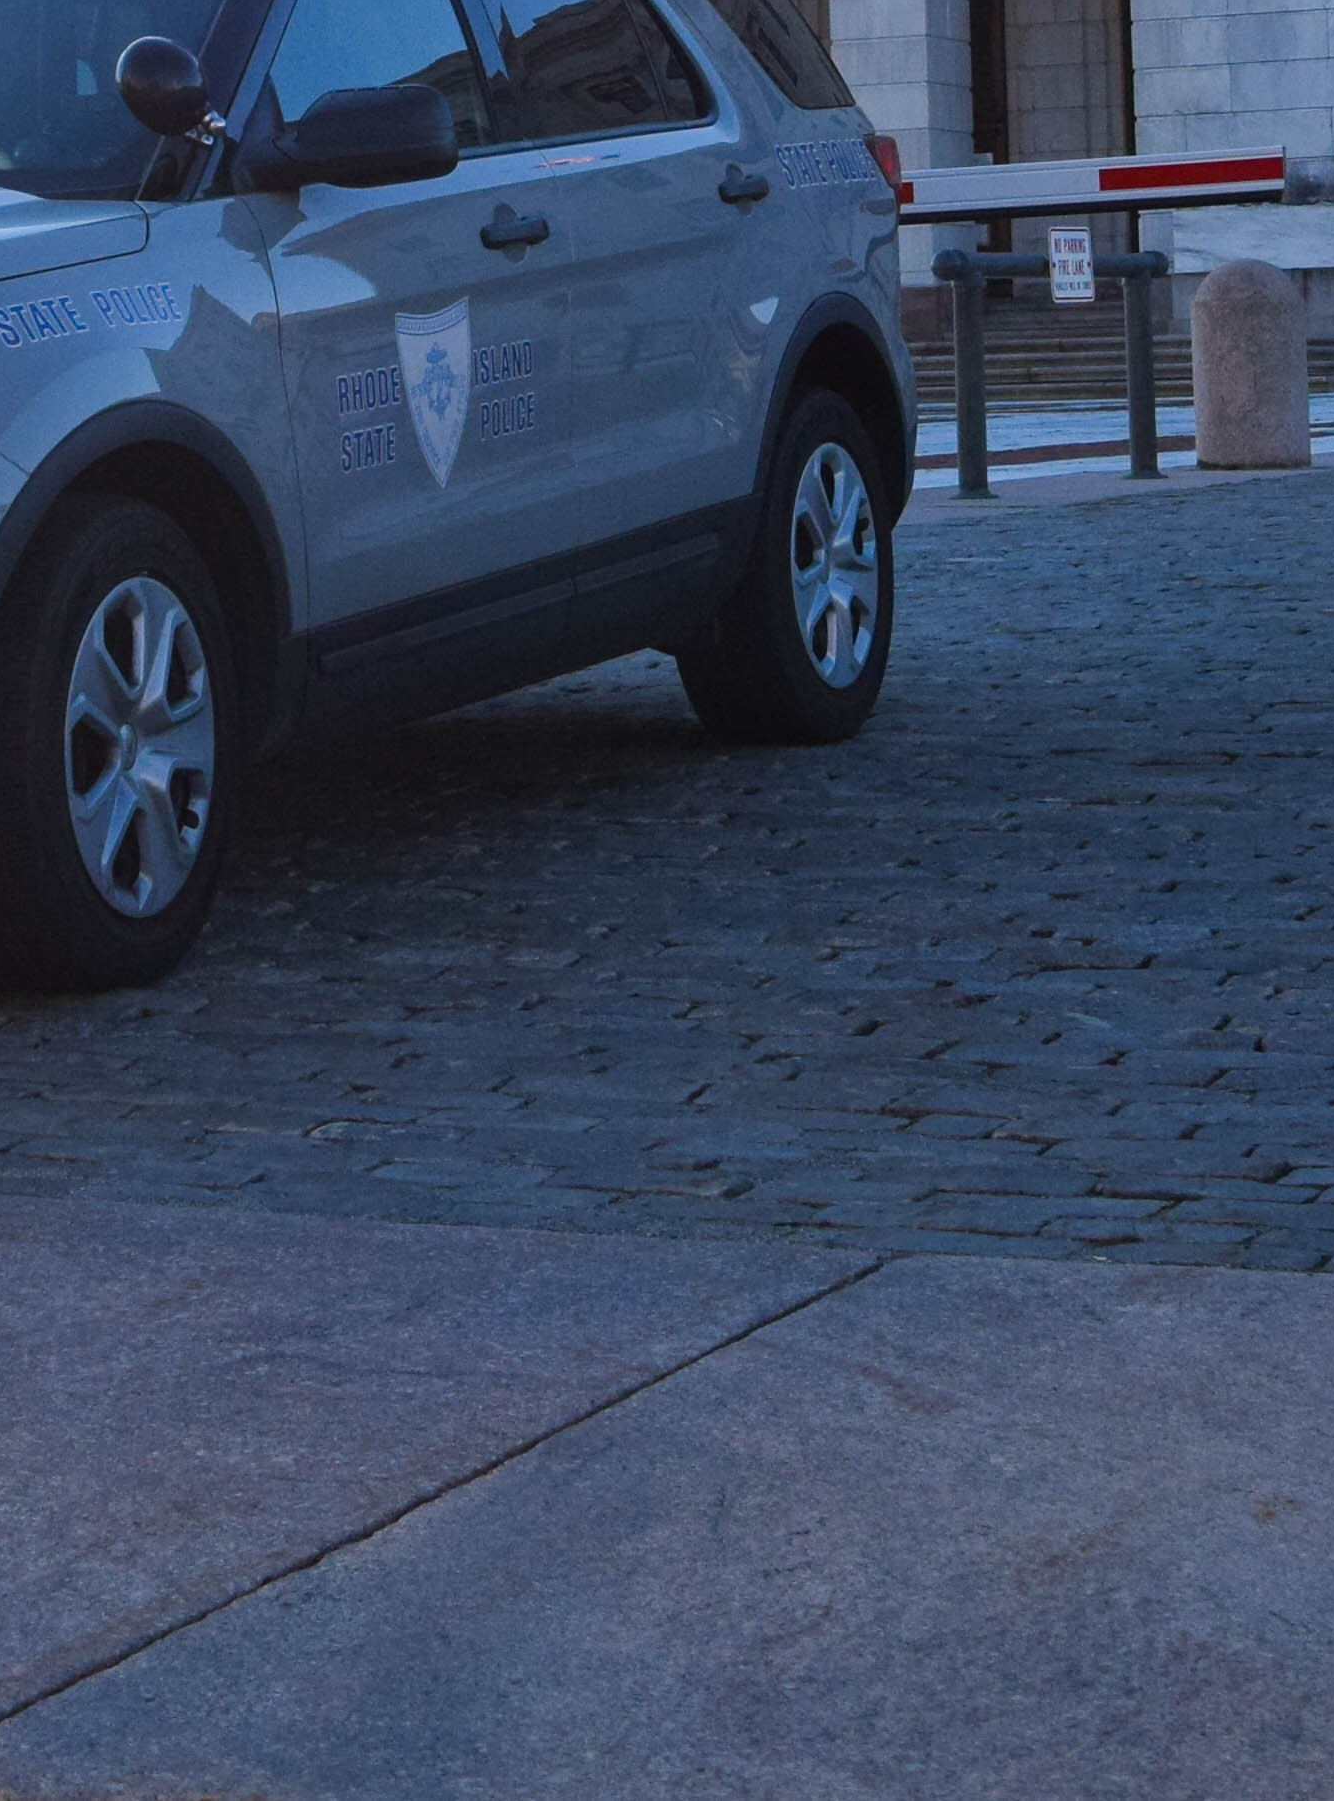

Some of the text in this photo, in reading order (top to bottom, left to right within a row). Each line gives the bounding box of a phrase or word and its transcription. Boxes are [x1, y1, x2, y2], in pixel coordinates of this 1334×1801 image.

[775, 142, 828, 190] STATE
[90, 283, 182, 327] POLICE
[336, 339, 533, 416] RHODE ISLAND
[341, 423, 396, 474] STATE
[480, 392, 536, 441] POLICE
